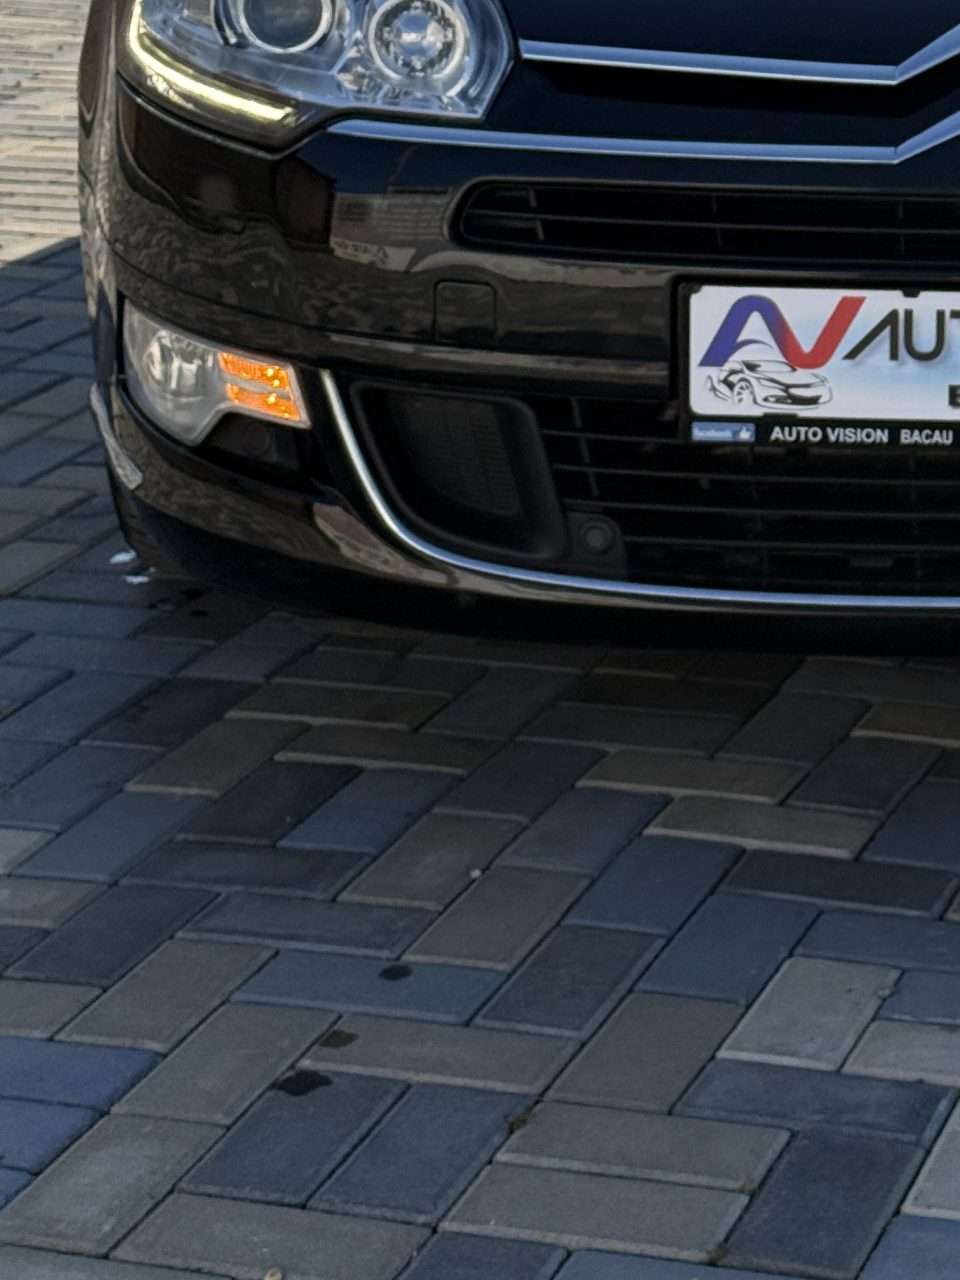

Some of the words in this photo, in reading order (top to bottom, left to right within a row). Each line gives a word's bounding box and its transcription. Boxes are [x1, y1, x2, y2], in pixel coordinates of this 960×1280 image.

[770, 426, 823, 443] AUTO
[825, 427, 889, 444] VISION
[900, 429, 953, 445] BACAU
